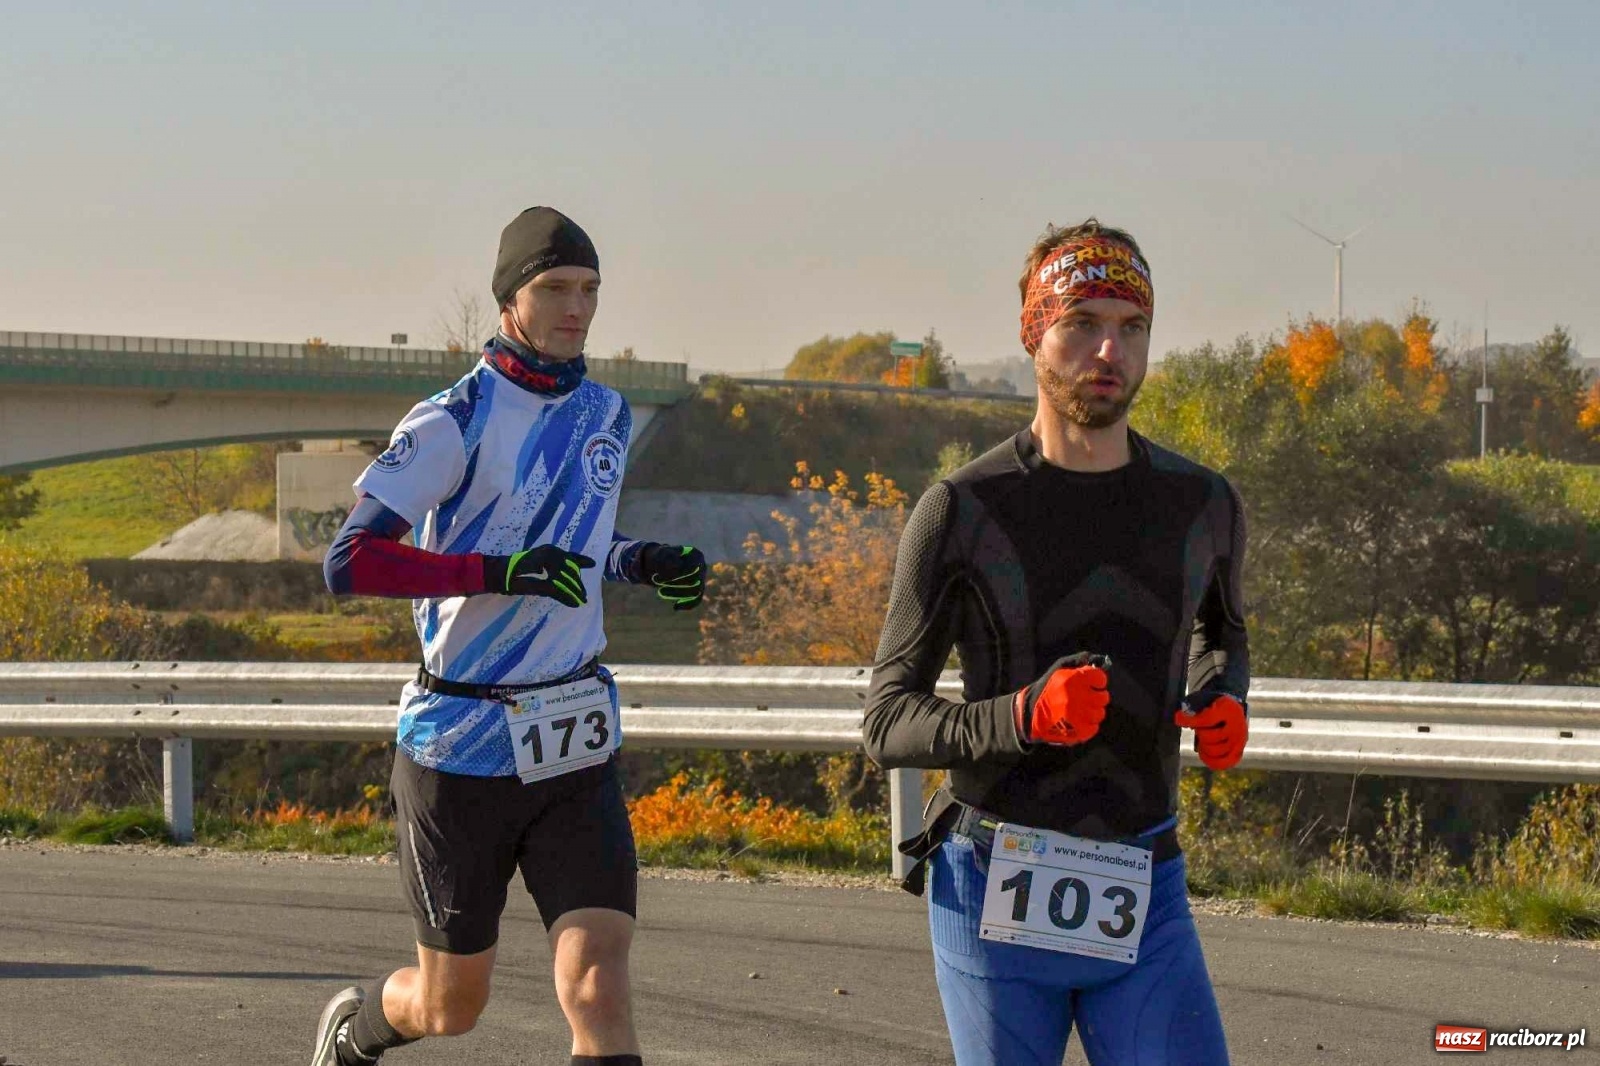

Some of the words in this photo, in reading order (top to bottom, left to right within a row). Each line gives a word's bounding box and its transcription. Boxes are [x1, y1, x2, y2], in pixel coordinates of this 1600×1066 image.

[599, 458, 611, 472] 40
[521, 710, 609, 765] 173
[1054, 846, 1147, 871] www.personalbest.pl
[1000, 869, 1138, 939] 103
